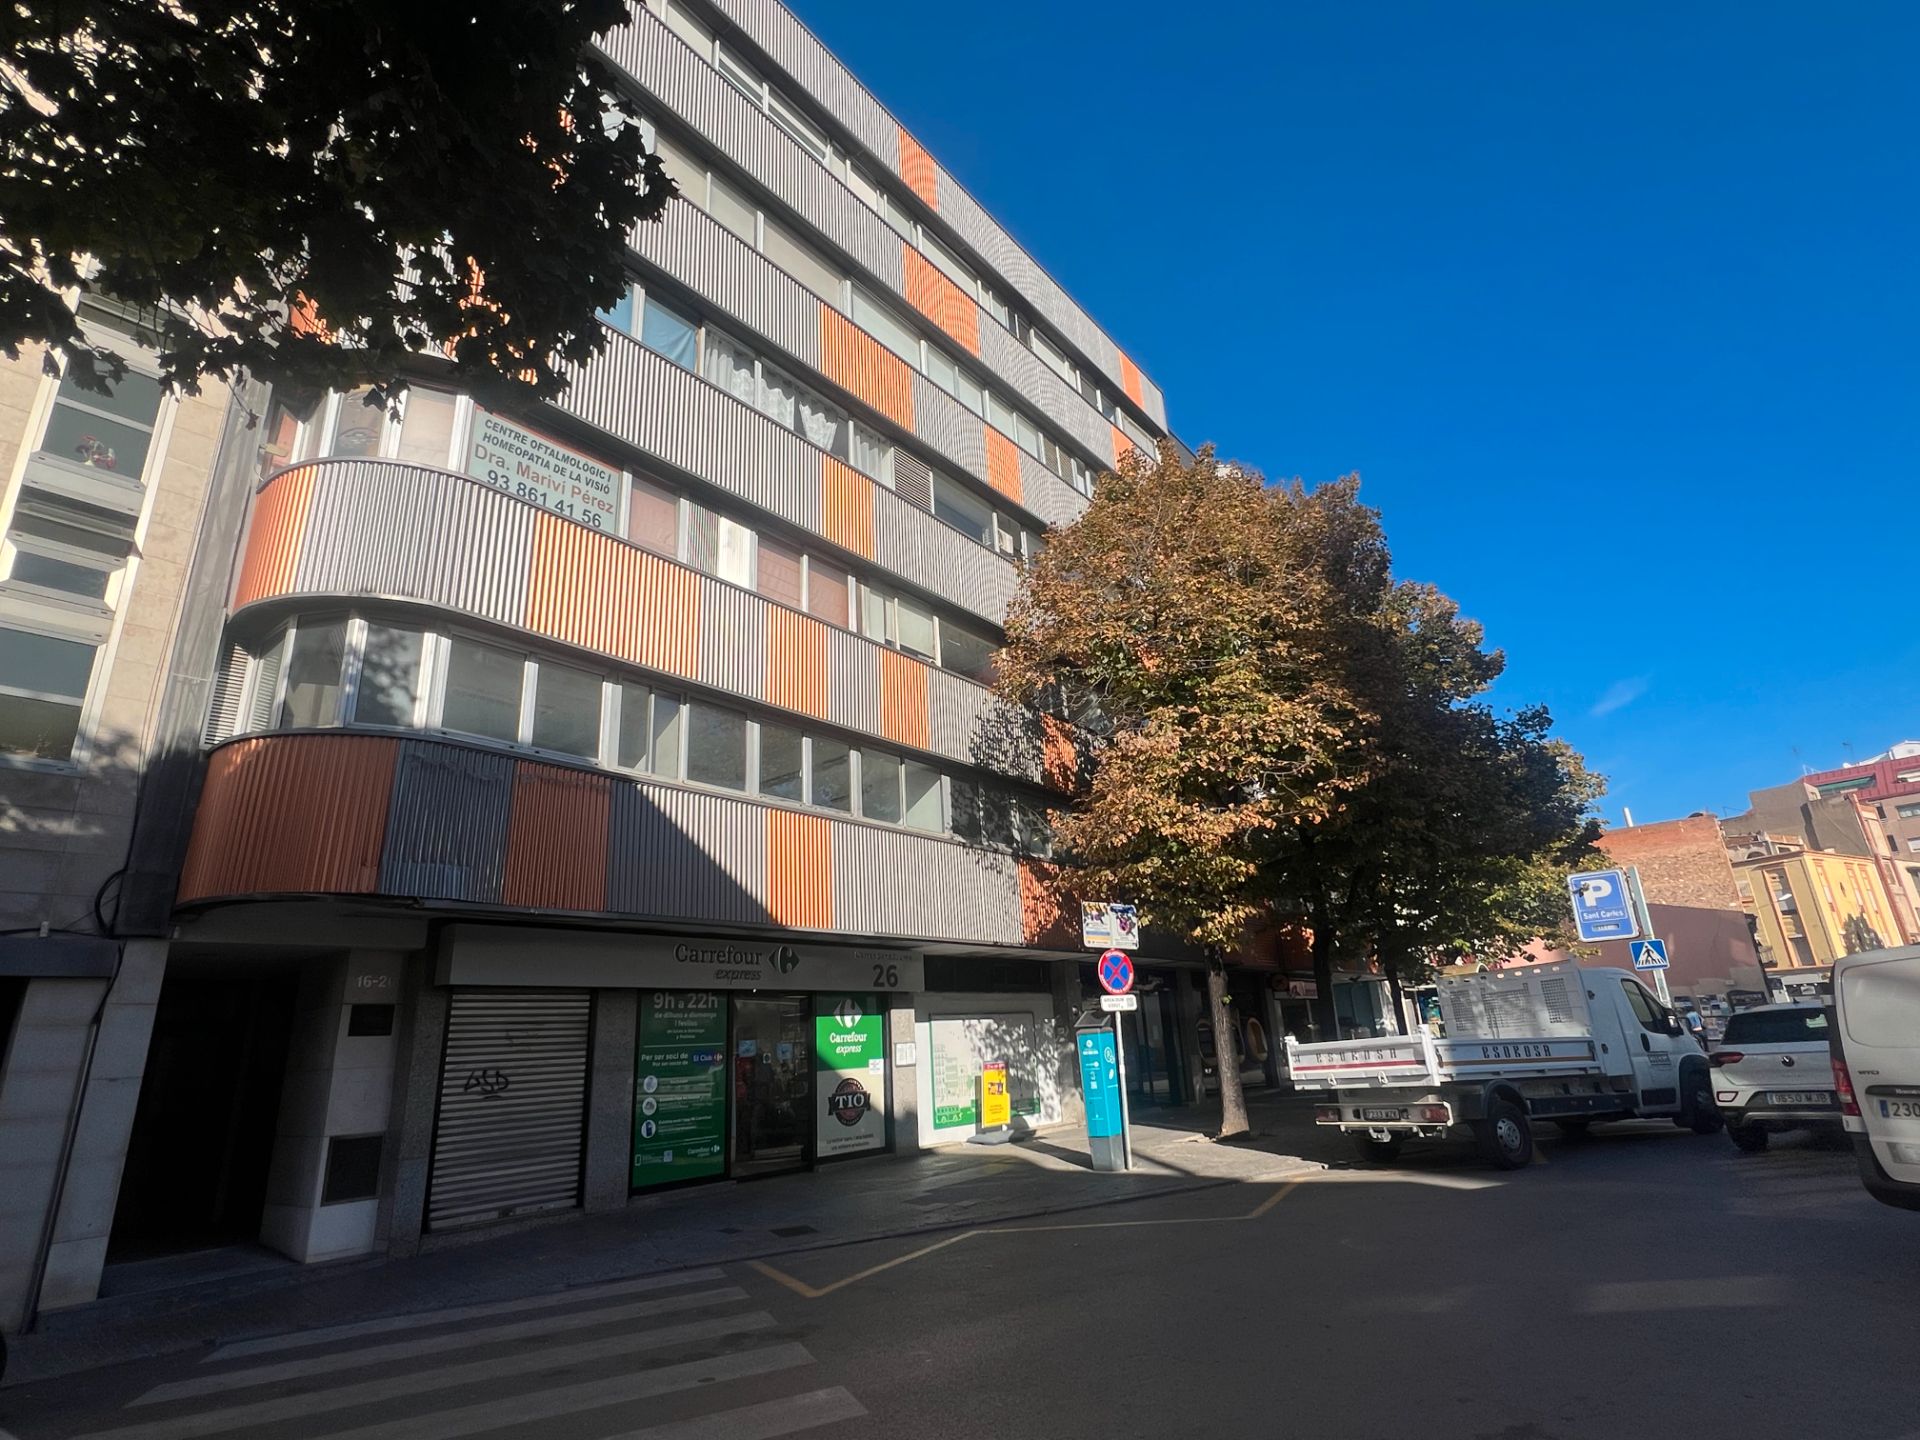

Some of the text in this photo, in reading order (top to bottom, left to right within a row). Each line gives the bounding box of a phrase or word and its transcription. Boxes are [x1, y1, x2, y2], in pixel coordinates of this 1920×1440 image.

[482, 432, 550, 470] HOMEOPATIA
[553, 464, 567, 477] DE
[569, 471, 582, 483] LA
[485, 419, 528, 445] CENTRE
[607, 473, 612, 482] I
[475, 443, 510, 471] Dra.
[571, 485, 614, 514] Pérez
[487, 469, 602, 528] 93 861 41 56
[1580, 879, 1612, 907] P
[1583, 911, 1600, 920] Sant
[673, 943, 763, 966] Carrefour
[715, 968, 762, 984] express
[872, 964, 899, 988] 26
[653, 992, 718, 1009] 9h a 22h
[829, 1031, 868, 1044] Carrefour
[835, 1044, 862, 1057] express
